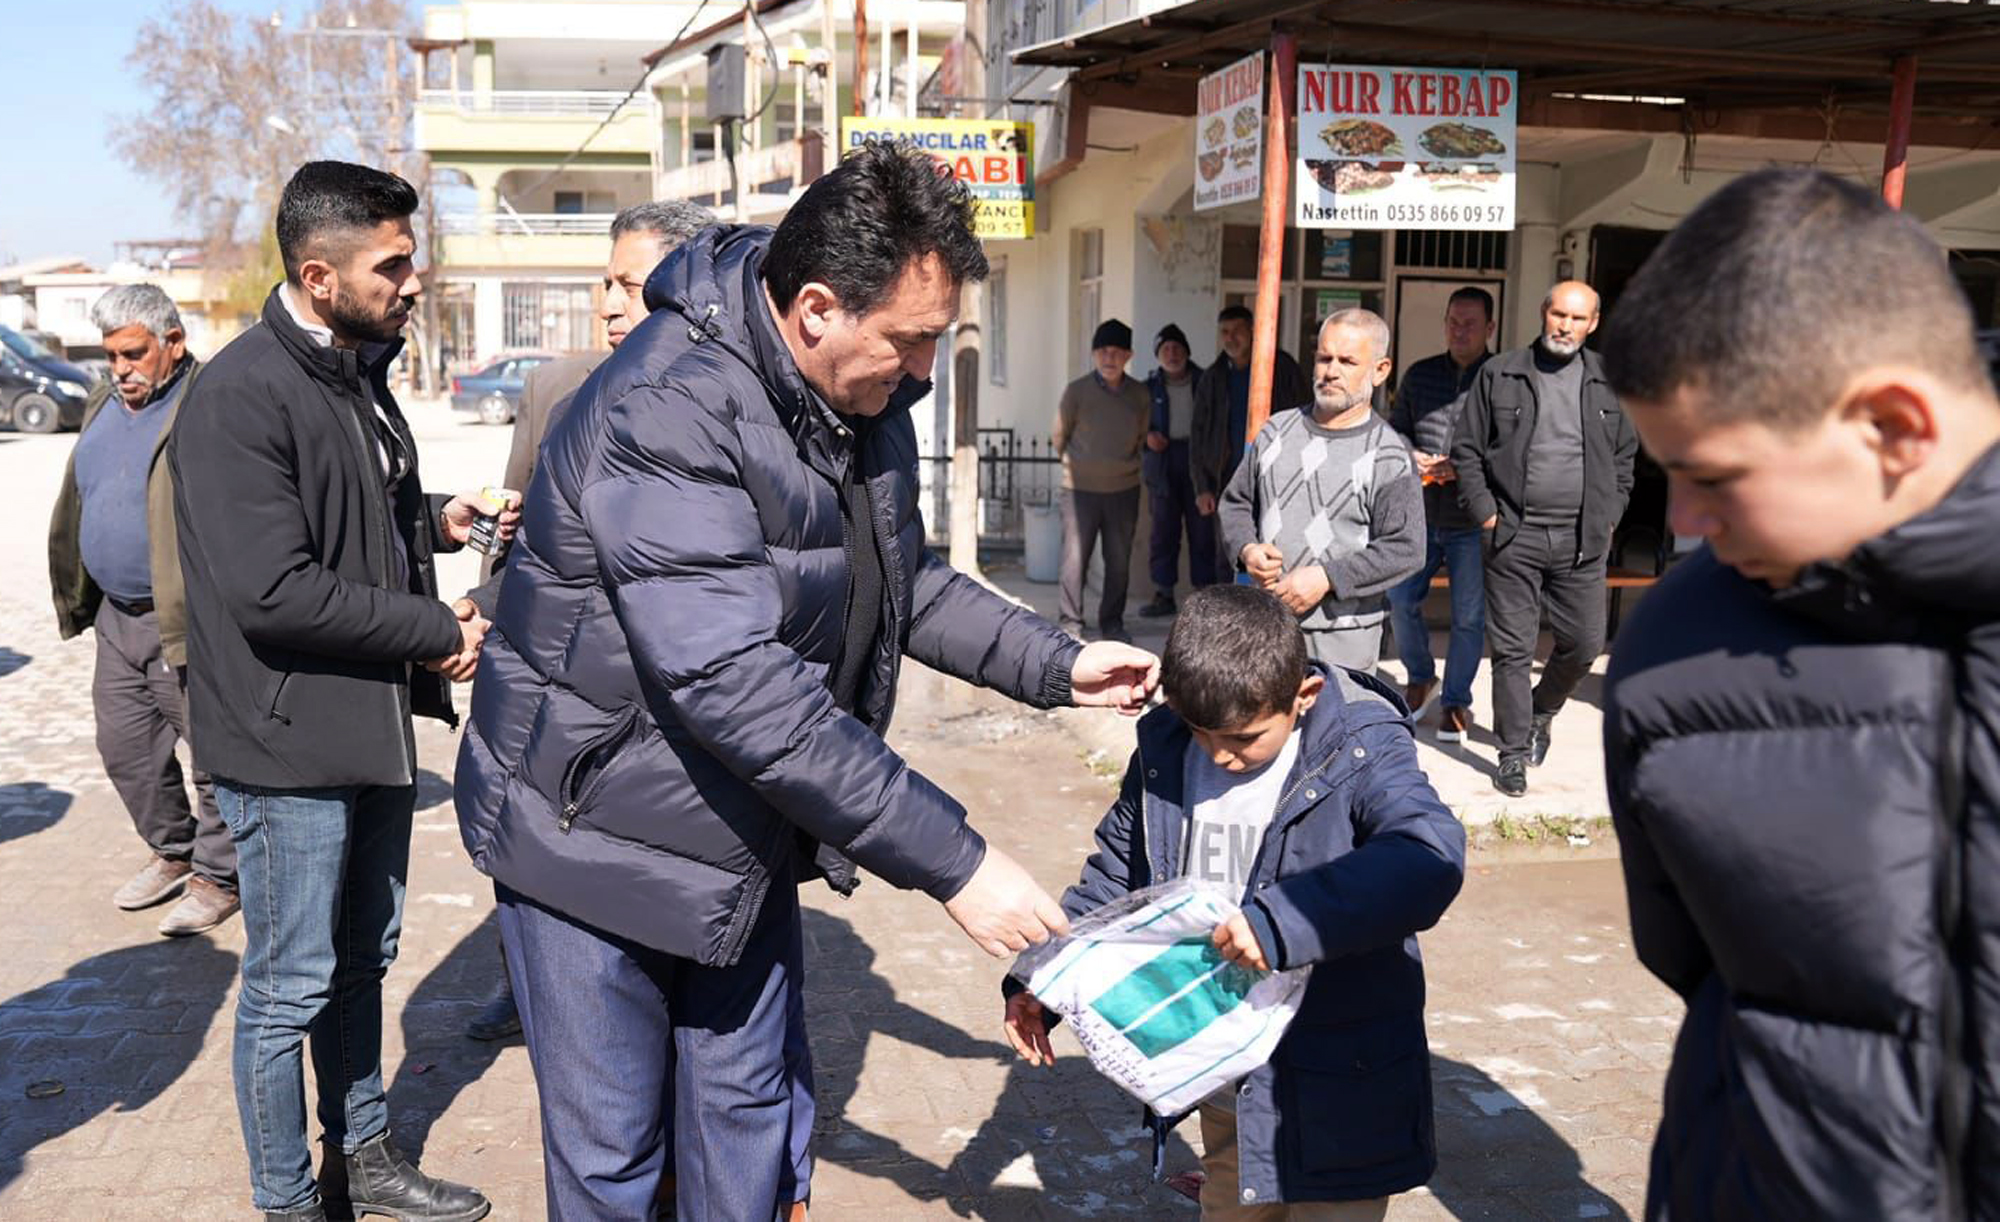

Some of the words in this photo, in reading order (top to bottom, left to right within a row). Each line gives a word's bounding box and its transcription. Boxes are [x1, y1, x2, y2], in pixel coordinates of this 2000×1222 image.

[1304, 70, 1381, 115] NUR
[1391, 72, 1512, 117] KEBAP
[1302, 203, 1378, 220] Nasrettin
[1387, 204, 1425, 221] 0535
[1430, 205, 1459, 222] 866
[1463, 206, 1482, 222] 09
[1487, 206, 1505, 222] 57
